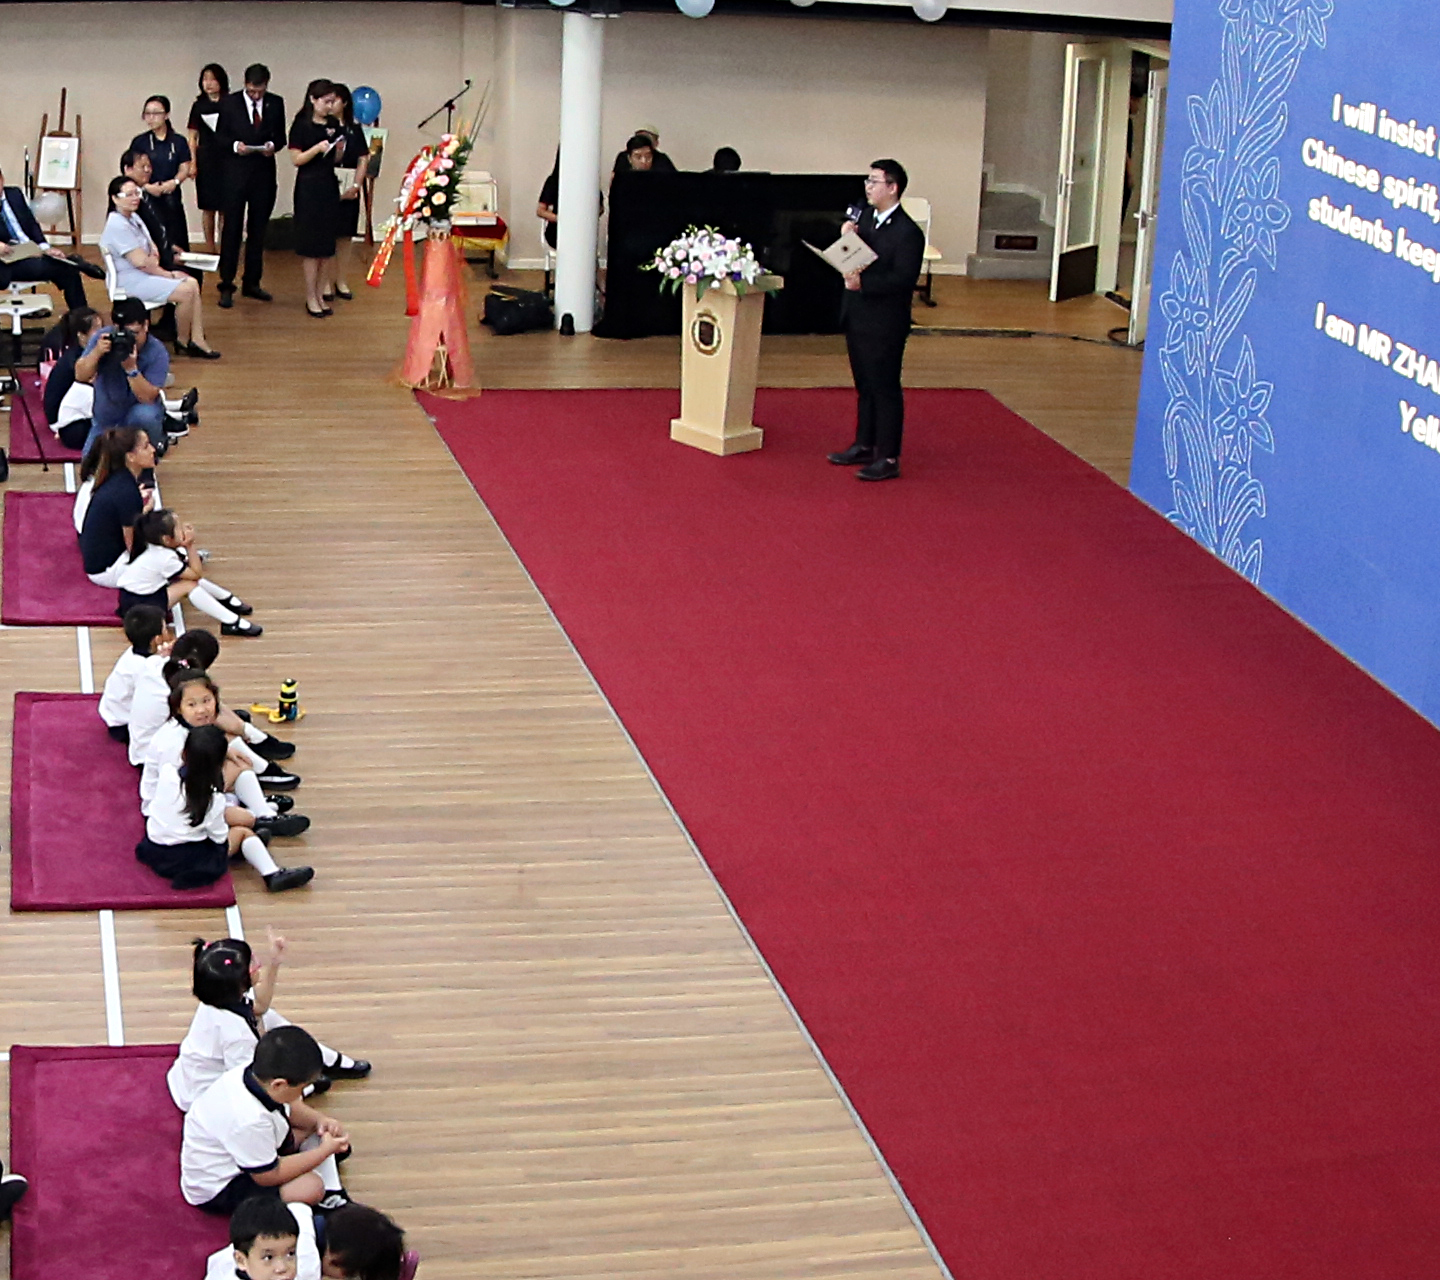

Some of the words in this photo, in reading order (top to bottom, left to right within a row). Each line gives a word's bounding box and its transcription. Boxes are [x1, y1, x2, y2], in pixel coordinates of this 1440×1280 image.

[1332, 93, 1342, 122] I
[1342, 102, 1377, 135] will
[1377, 108, 1437, 157] insist
[1301, 137, 1381, 193] Chinese
[1382, 175, 1440, 224] spirit,
[1308, 195, 1393, 254] students
[1315, 301, 1325, 330] I
[1324, 314, 1356, 347] am
[1357, 323, 1393, 367] MR
